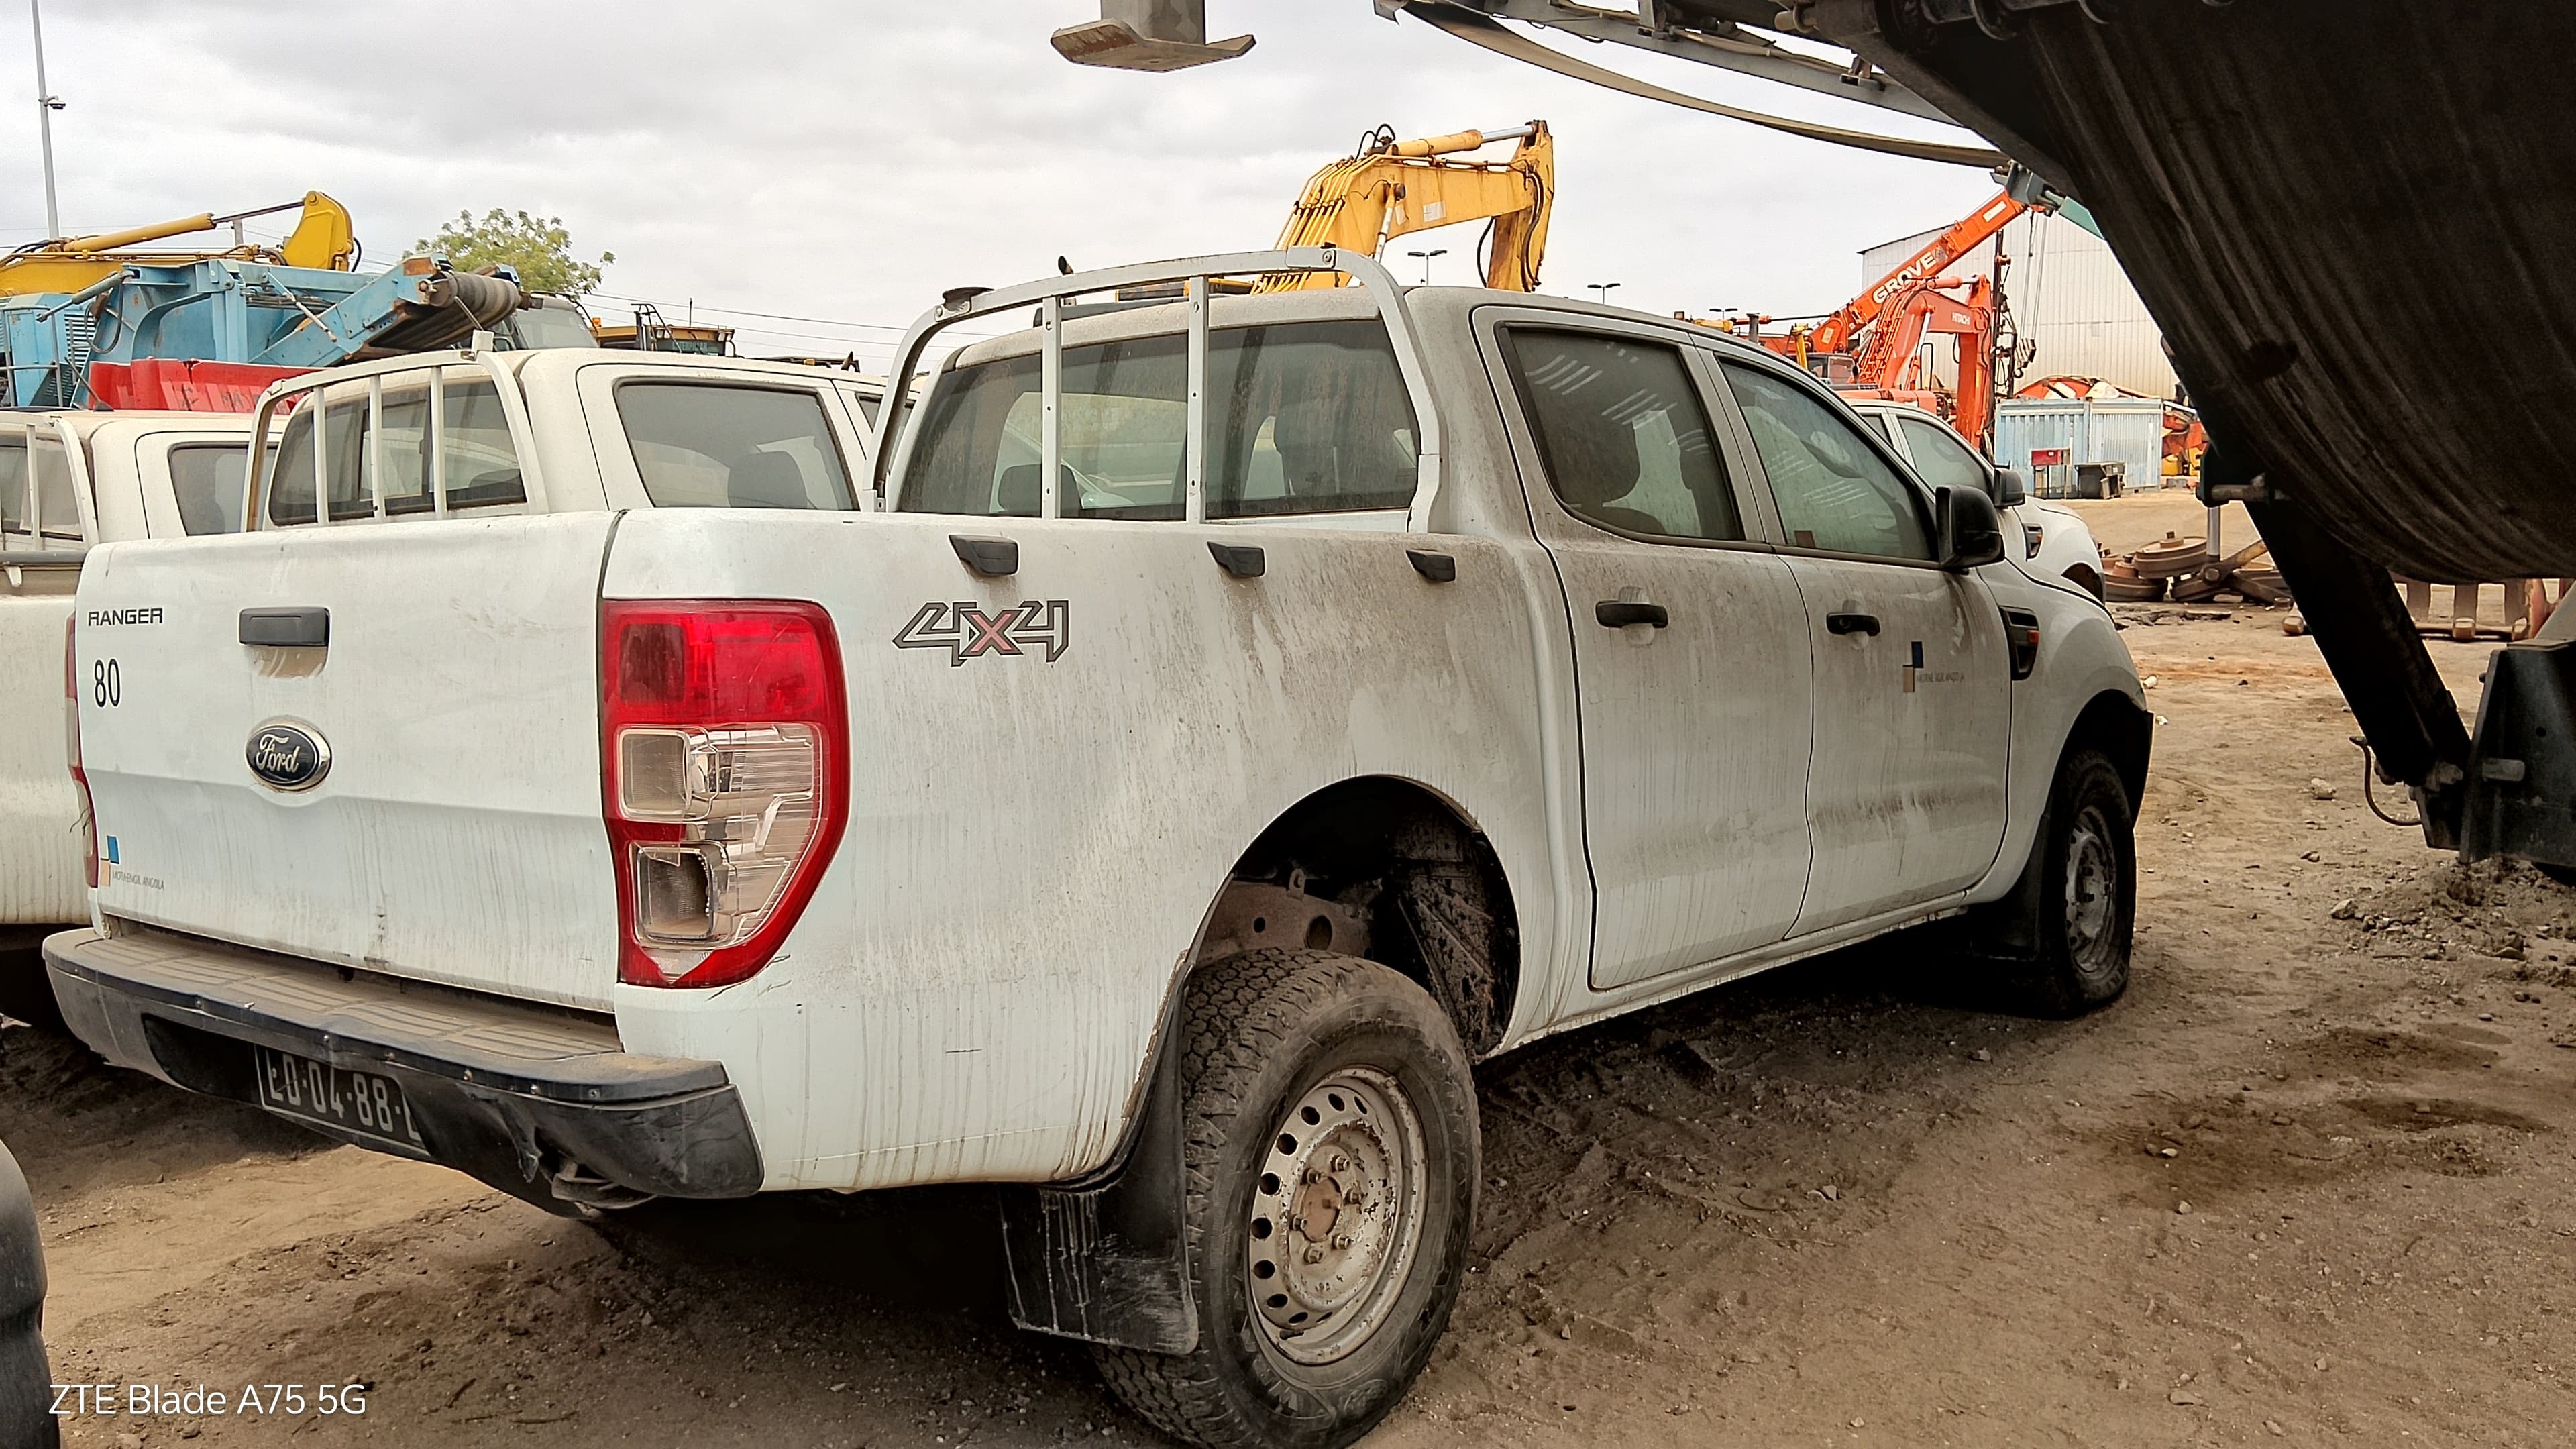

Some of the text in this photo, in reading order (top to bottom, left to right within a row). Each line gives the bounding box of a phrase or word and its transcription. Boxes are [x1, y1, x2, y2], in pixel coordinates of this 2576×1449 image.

[1873, 252, 1936, 303] GROVE
[1951, 311, 1970, 325] HITACHI
[88, 608, 164, 627] RANGER
[94, 658, 121, 708] 80
[256, 733, 301, 773] Ford
